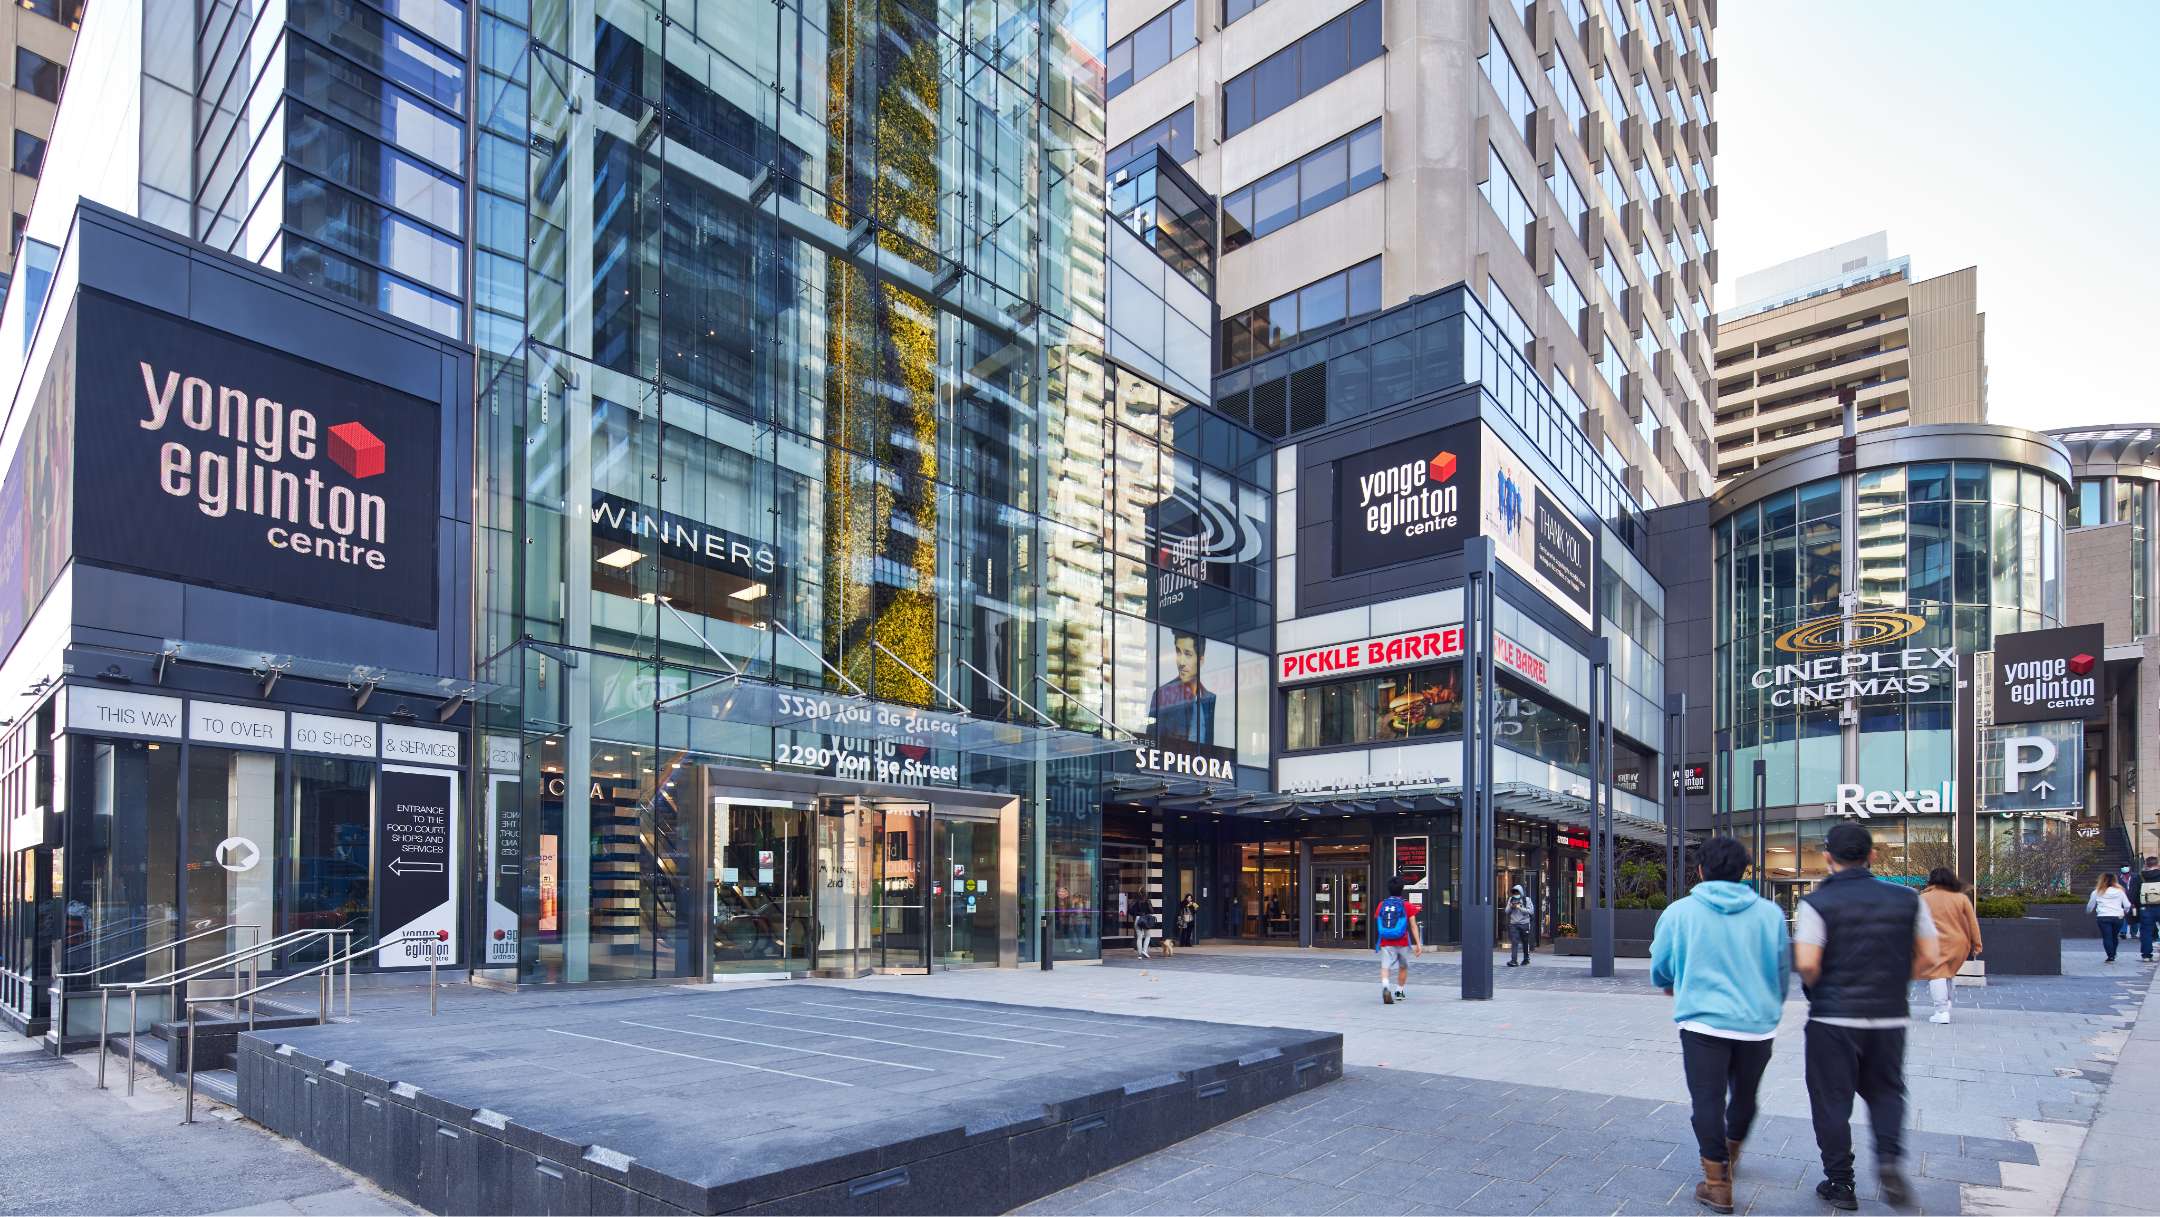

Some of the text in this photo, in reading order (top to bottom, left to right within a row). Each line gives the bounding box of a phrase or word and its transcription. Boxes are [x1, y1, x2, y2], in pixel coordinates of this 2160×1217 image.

[140, 361, 317, 462] yonge
[160, 442, 386, 544] eglinton
[1360, 460, 1426, 507] yonge
[1367, 486, 1457, 534] eglinton
[1406, 516, 1457, 536] centre
[267, 527, 386, 570] centre
[592, 502, 775, 574] WINNERS
[1540, 506, 1565, 554] THANK
[1565, 531, 1582, 569] YOU.
[1284, 646, 1360, 678] PICKLE
[1516, 647, 1547, 684] BARREL
[1751, 646, 1957, 689] CINEPLEX
[2004, 658, 2066, 686] yonge
[1770, 675, 1930, 707] CINEMAS
[2011, 677, 2095, 705] eglinton
[2048, 697, 2095, 709] centre
[97, 705, 456, 758] THIS WAY TO OVER 60 SHOPS & SERVICES
[777, 744, 831, 767] 2290
[904, 758, 958, 781] Street
[1135, 747, 1234, 780] SEPHORA
[2004, 736, 2056, 792] P
[397, 804, 444, 815] ENTRANCE
[1836, 780, 1957, 819] Rexall
[387, 823, 446, 835] FOOD COURT,
[413, 815, 444, 825] TO THE
[2076, 829, 2100, 838] VIP
[391, 834, 444, 844] SHOPS AND
[401, 844, 444, 854] SERVICES
[405, 941, 449, 959] eglinon
